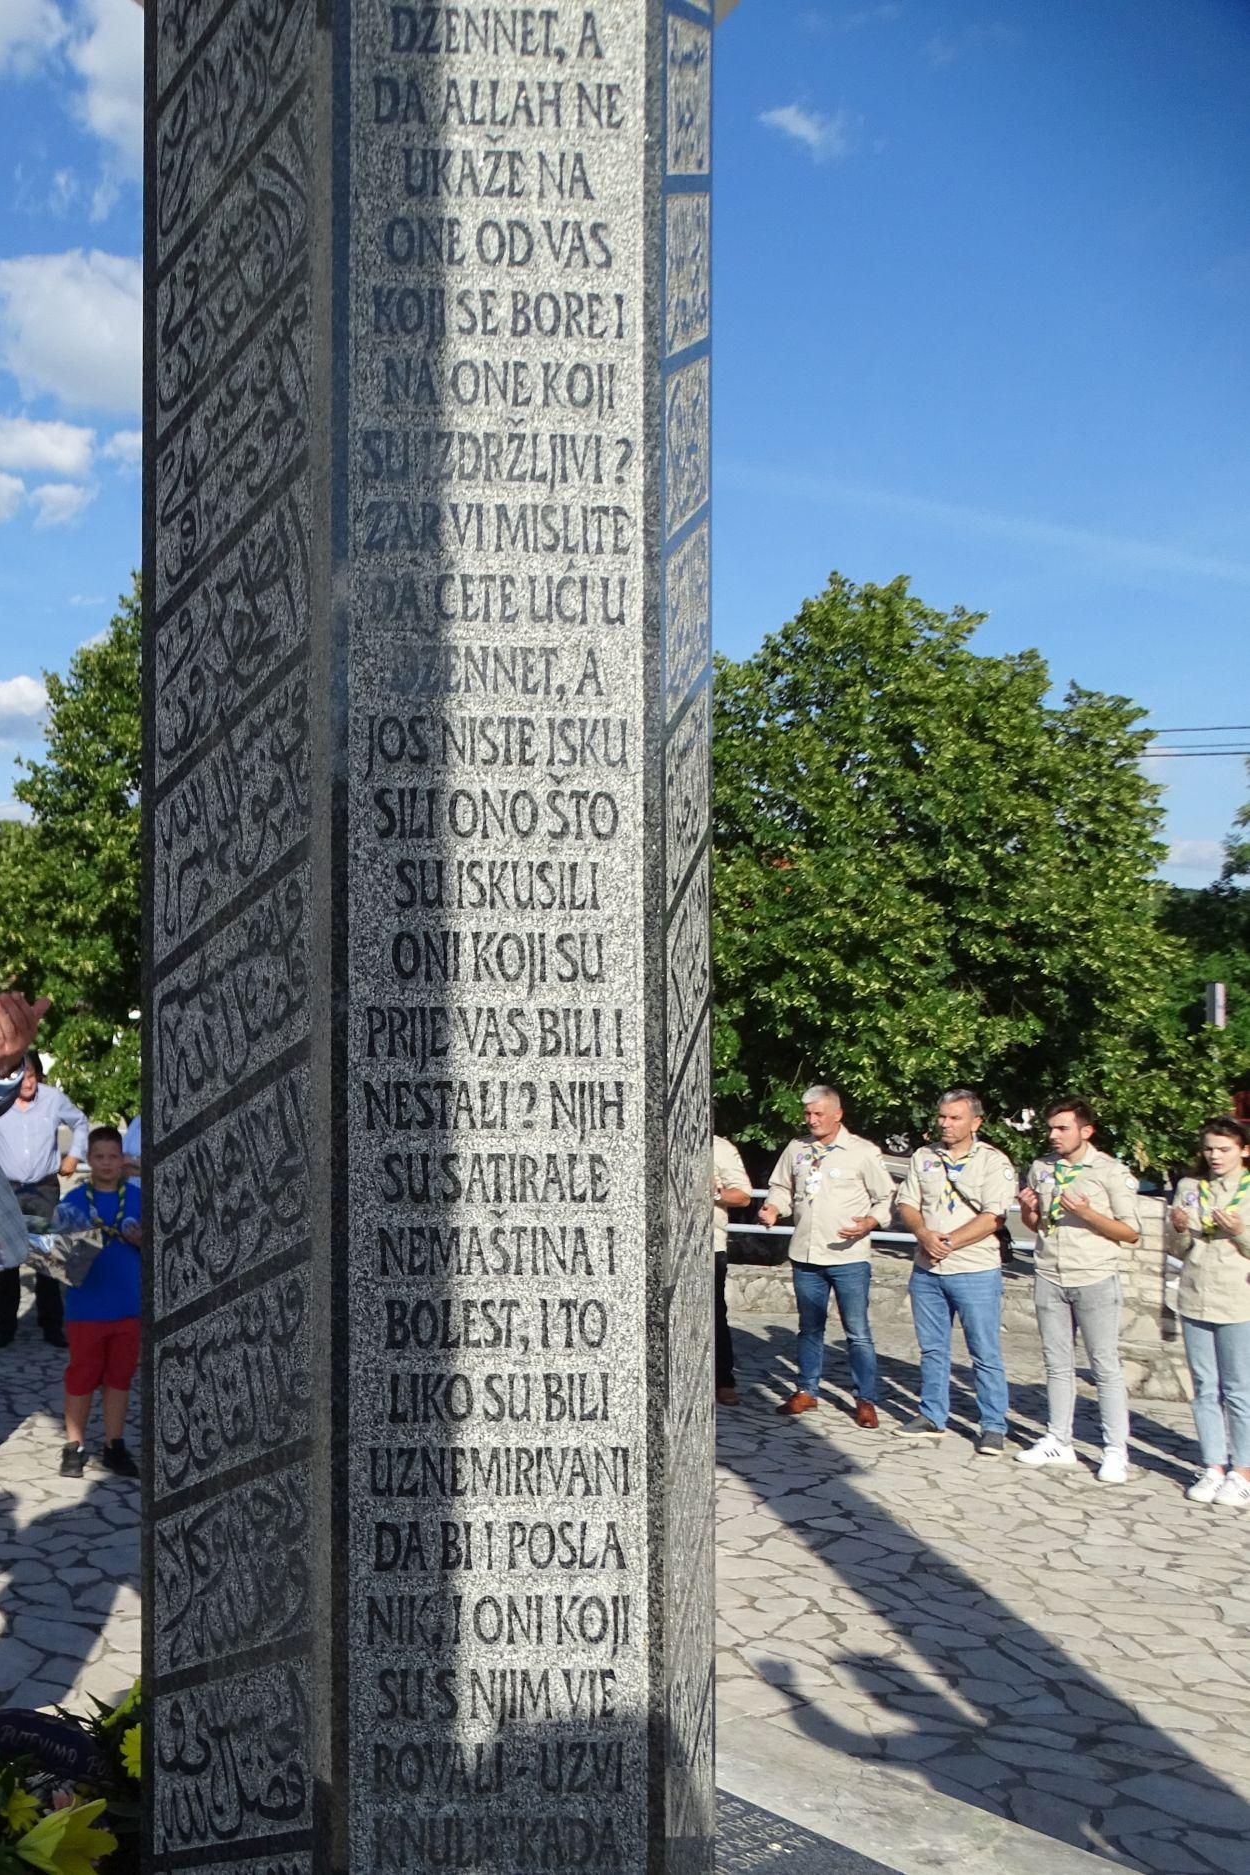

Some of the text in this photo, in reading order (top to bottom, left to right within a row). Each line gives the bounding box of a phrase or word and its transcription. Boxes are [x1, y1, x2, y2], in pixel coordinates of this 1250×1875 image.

[576, 11, 604, 59] A
[372, 75, 625, 129] DA ALLAH NE
[402, 134, 596, 200] UKAŽE NA
[384, 217, 612, 268] ONE OD VAS
[372, 287, 625, 349] KOJI SE BORE I
[382, 358, 616, 418] NA ONE KOJI
[362, 501, 633, 555] ZAR VI MISLITE
[367, 571, 424, 622] DA
[528, 559, 588, 625] UĆI
[601, 576, 626, 625] U
[575, 648, 604, 697] A
[441, 716, 535, 766] NISTE
[547, 717, 628, 768] ISKU
[373, 773, 619, 840] SILI ONO ŠTO
[395, 859, 601, 910] SU ISKUSILI
[391, 931, 604, 996] ONI KOJI SU
[366, 1006, 624, 1073] PRIJE VAS BILI I
[550, 1080, 626, 1143] NJIH
[380, 1153, 610, 1203] SU SATIRALE
[378, 1209, 616, 1276] NEMAŠTINA I
[385, 1299, 608, 1355] BOLEST, I TO
[389, 1373, 610, 1423] LIKO SU BILI
[369, 1447, 630, 1497] UZNEMIRIVANI
[373, 1521, 627, 1571] DA BI I POSLA
[452, 1595, 462, 1645] I
[473, 1595, 543, 1645] ONI
[555, 1595, 630, 1658] KOJI
[377, 1669, 618, 1734] SU S NJIM VJE
[372, 1742, 503, 1793] ROVALI
[541, 1742, 623, 1793] UZVI
